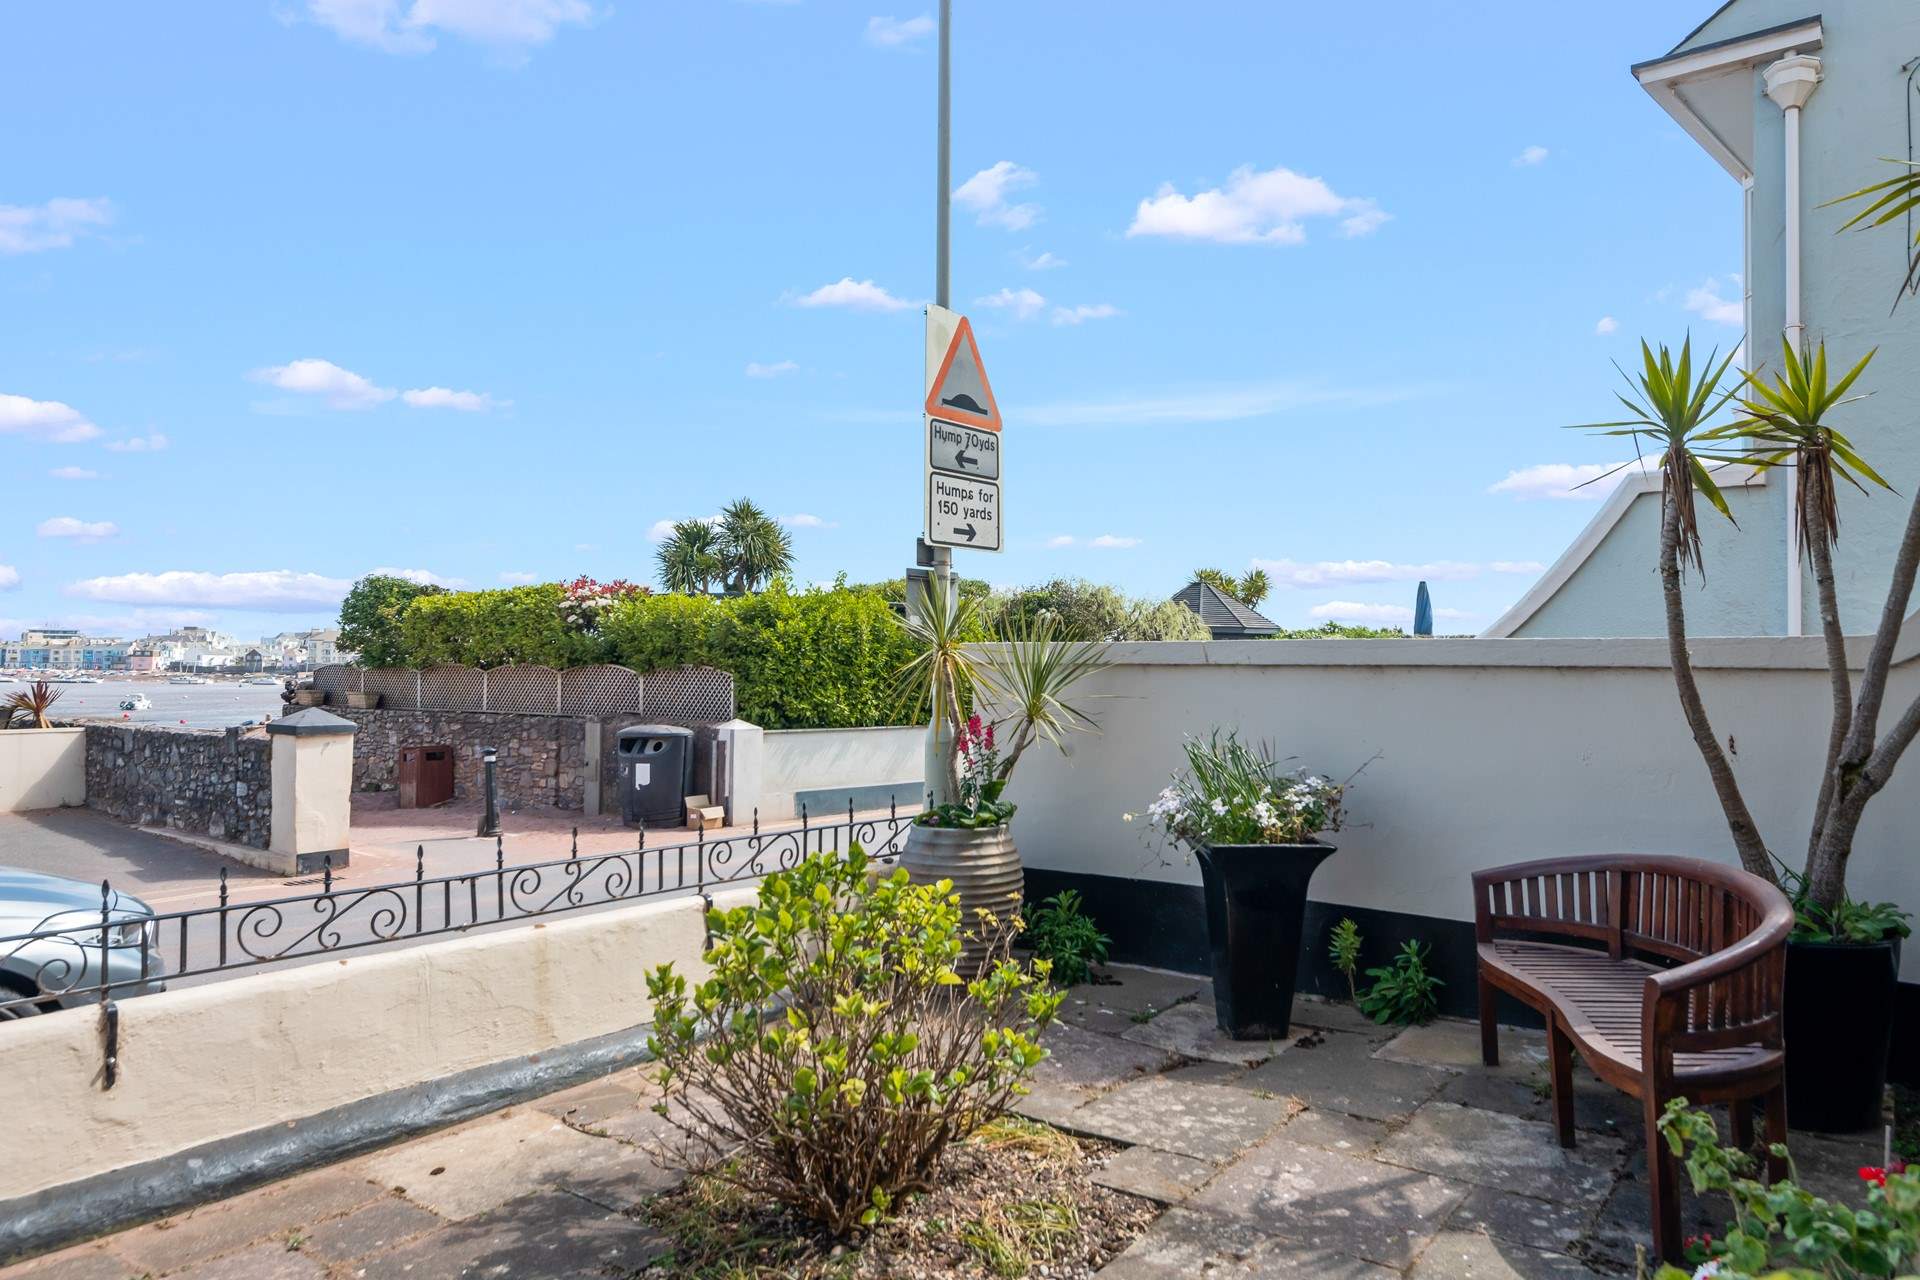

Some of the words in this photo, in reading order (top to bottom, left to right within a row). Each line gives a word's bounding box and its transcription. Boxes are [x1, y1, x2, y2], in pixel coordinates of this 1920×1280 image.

[934, 425, 962, 446] Hump
[936, 481, 974, 501] Humps
[978, 489, 994, 503] for
[937, 500, 958, 516] 150
[963, 507, 992, 521] yards
